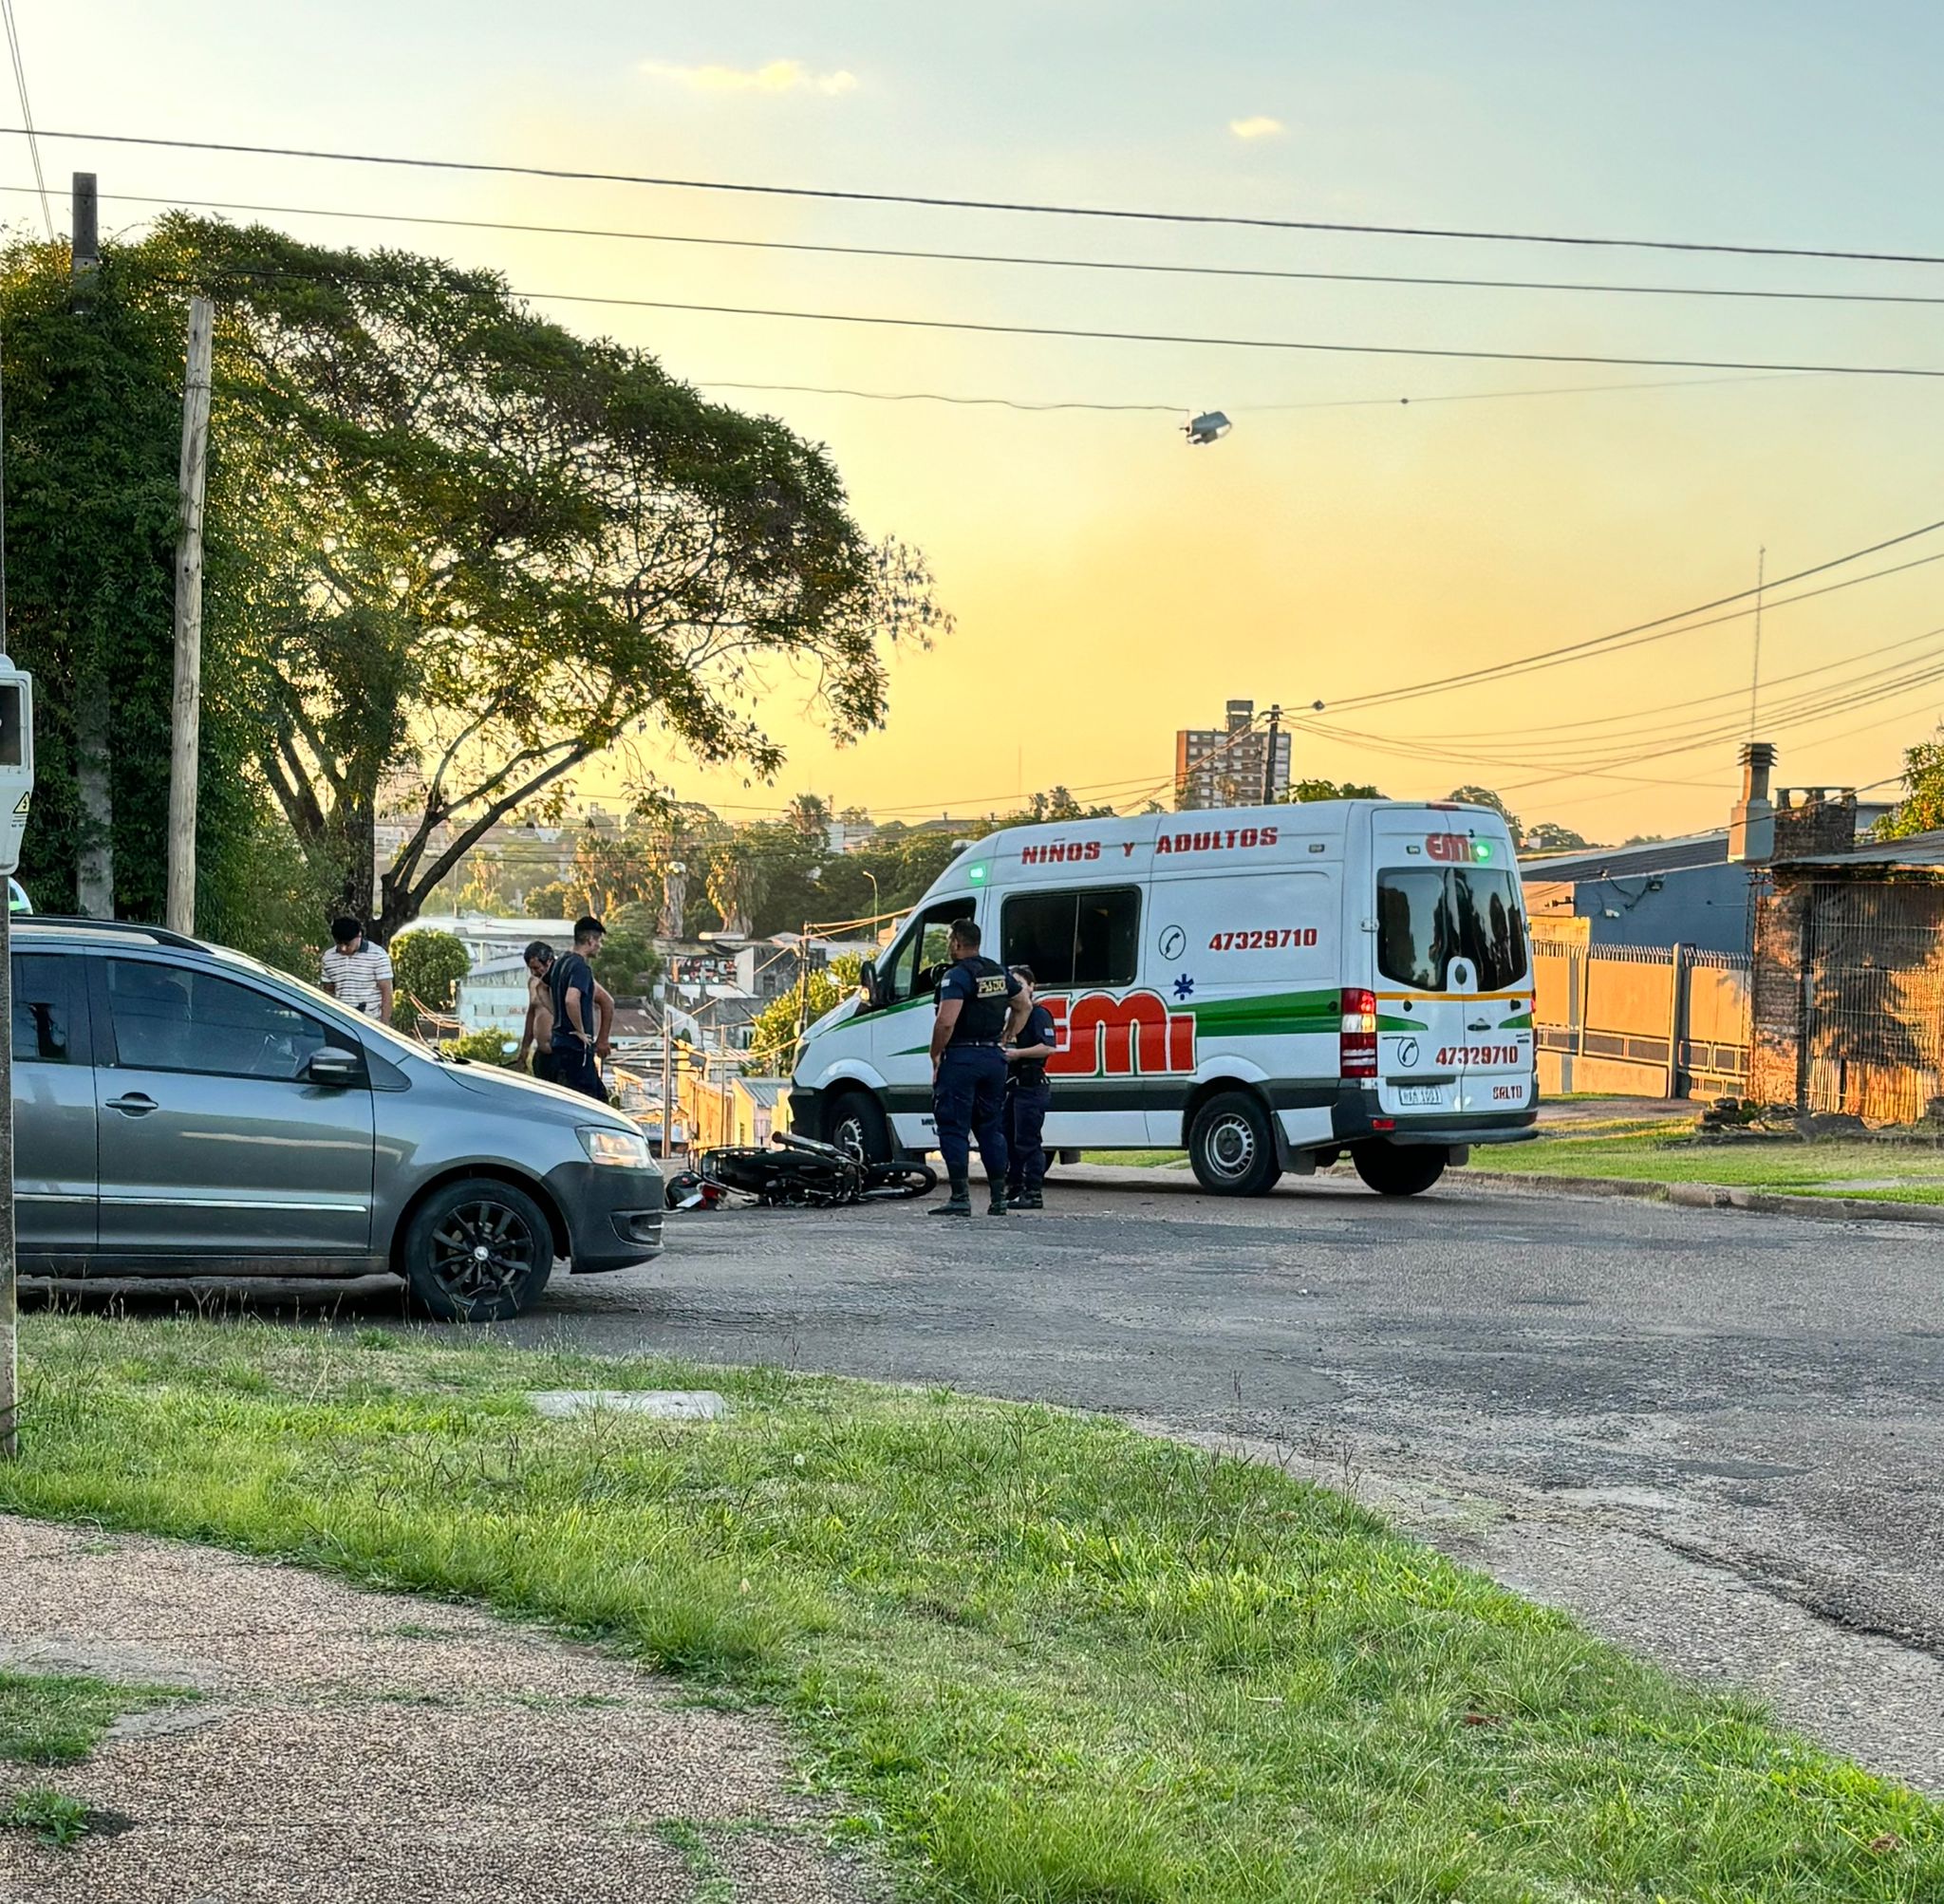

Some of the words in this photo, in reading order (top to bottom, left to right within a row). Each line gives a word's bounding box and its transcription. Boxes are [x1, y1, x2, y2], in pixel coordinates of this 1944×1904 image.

[1021, 838, 1101, 865] NIÑOS
[1122, 842, 1135, 857] Y
[1156, 827, 1279, 854] ADULTOS
[1208, 928, 1318, 951] 47329710
[1435, 1045, 1519, 1066] 47329710
